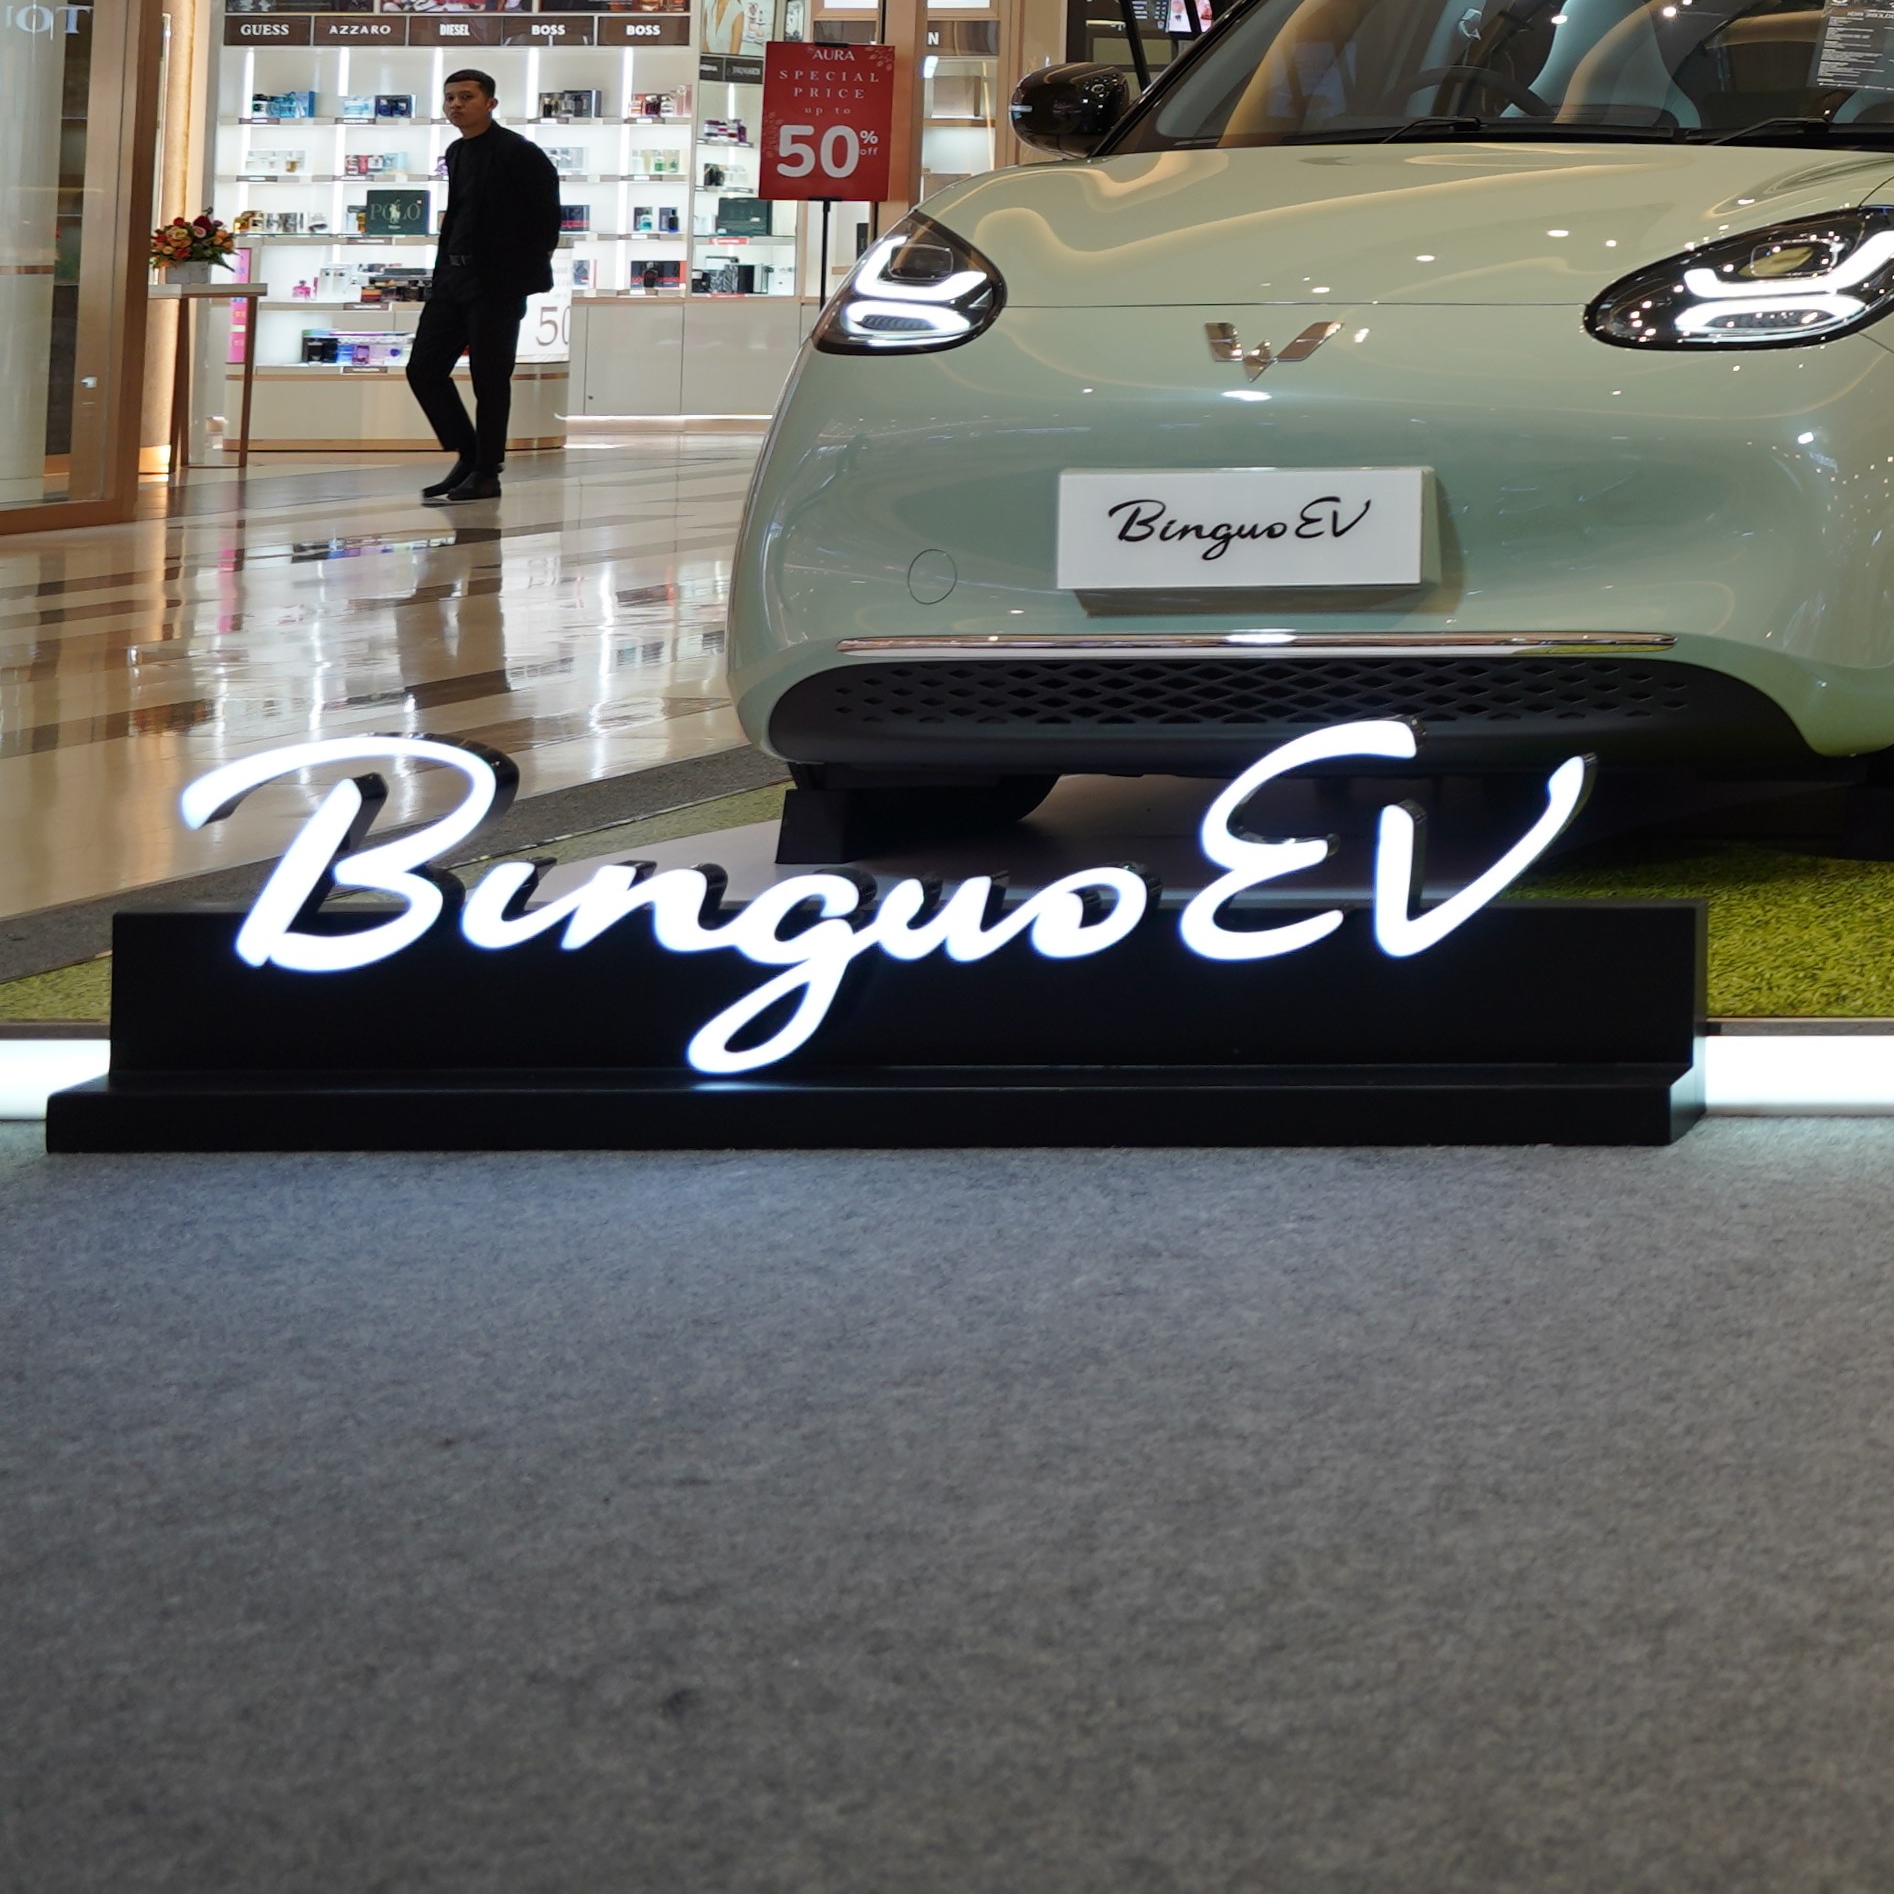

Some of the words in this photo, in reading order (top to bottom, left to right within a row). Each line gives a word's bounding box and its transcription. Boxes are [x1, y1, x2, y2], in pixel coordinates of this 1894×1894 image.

[240, 23, 290, 36] GUESS
[329, 25, 392, 35] AZZARO
[439, 24, 470, 36] DIESEL
[531, 24, 566, 36] BOSS
[625, 24, 661, 36] BOSS
[812, 49, 855, 61] AURA
[779, 70, 880, 83] SPECIAL
[793, 87, 865, 99] PRICE
[804, 107, 823, 117] up
[835, 105, 851, 115] to
[1108, 499, 1288, 561] Binguo
[1294, 496, 1372, 540] EV
[180, 730, 1150, 1074] Binguo
[1180, 716, 1595, 961] EV
